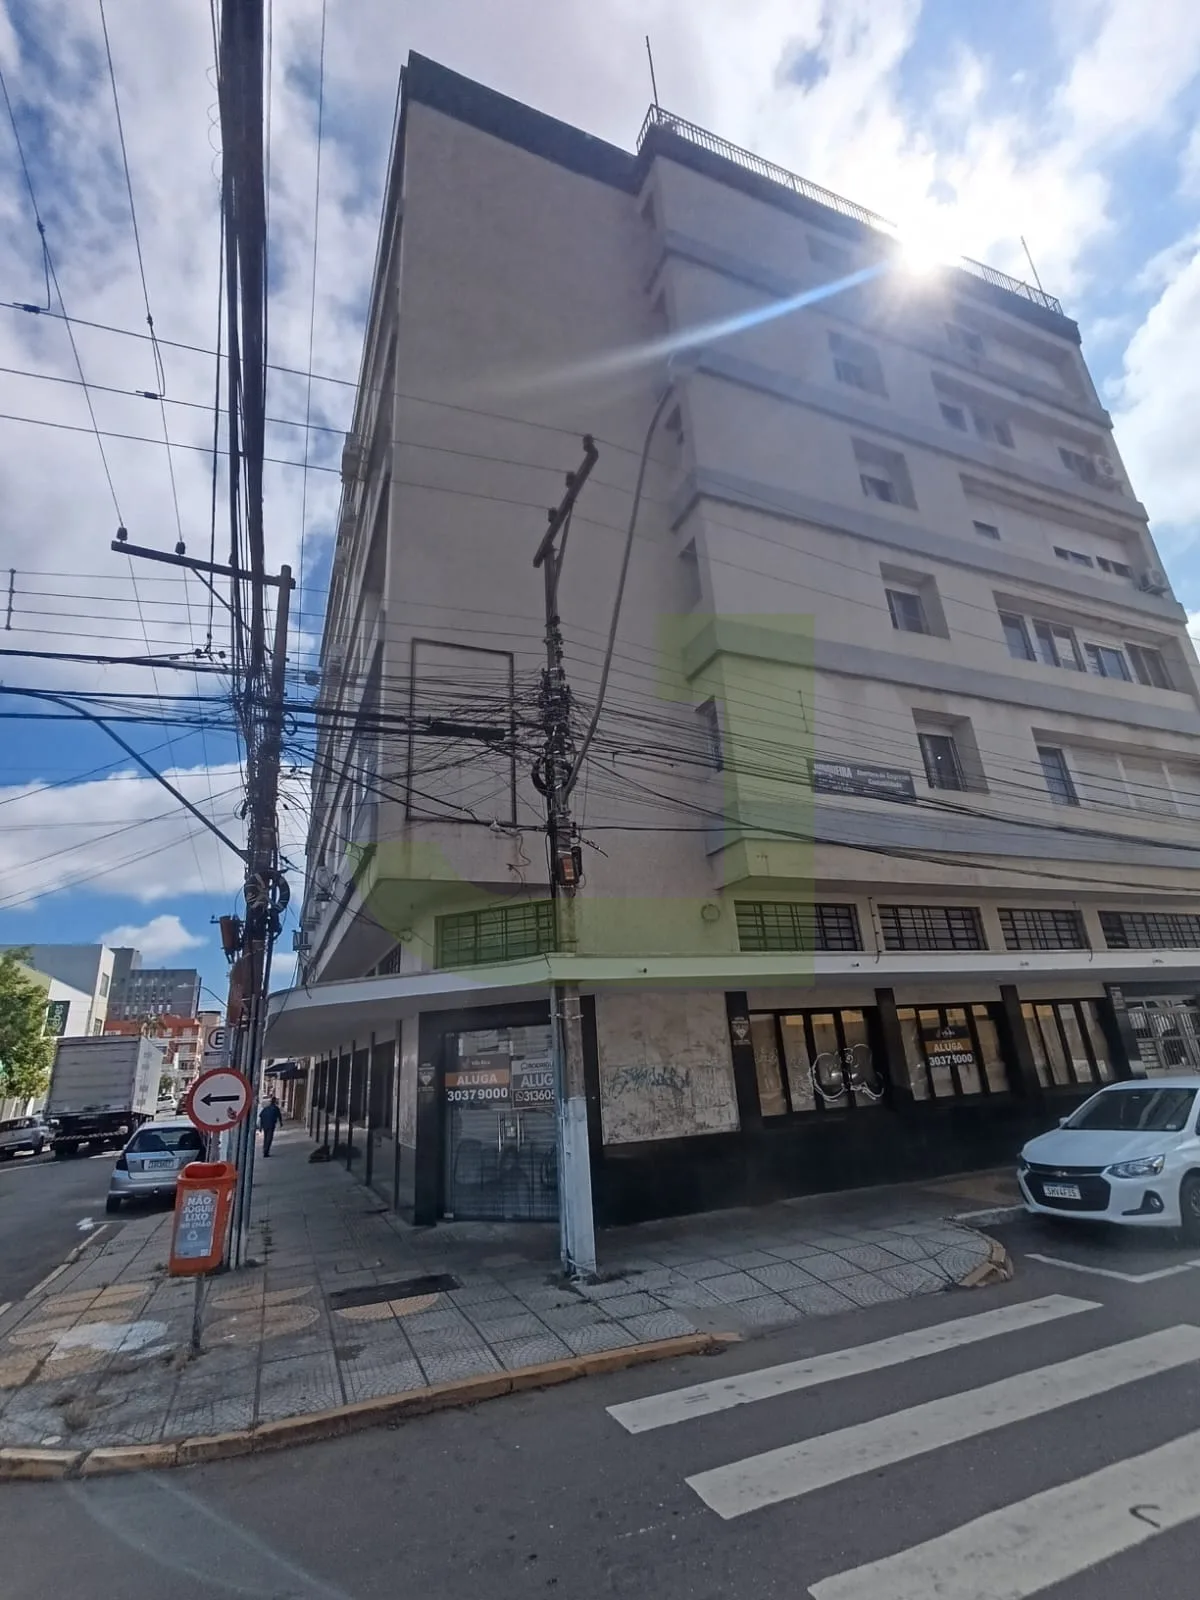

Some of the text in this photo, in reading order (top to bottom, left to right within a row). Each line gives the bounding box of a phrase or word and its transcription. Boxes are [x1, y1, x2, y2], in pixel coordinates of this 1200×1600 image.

[215, 1032, 225, 1045] E
[934, 1042, 963, 1053] ALUGA
[457, 1073, 498, 1086] ALUGA
[521, 1073, 554, 1088] ALUG
[187, 1194, 212, 1206] NÃO
[185, 1213, 209, 1222] LIXO
